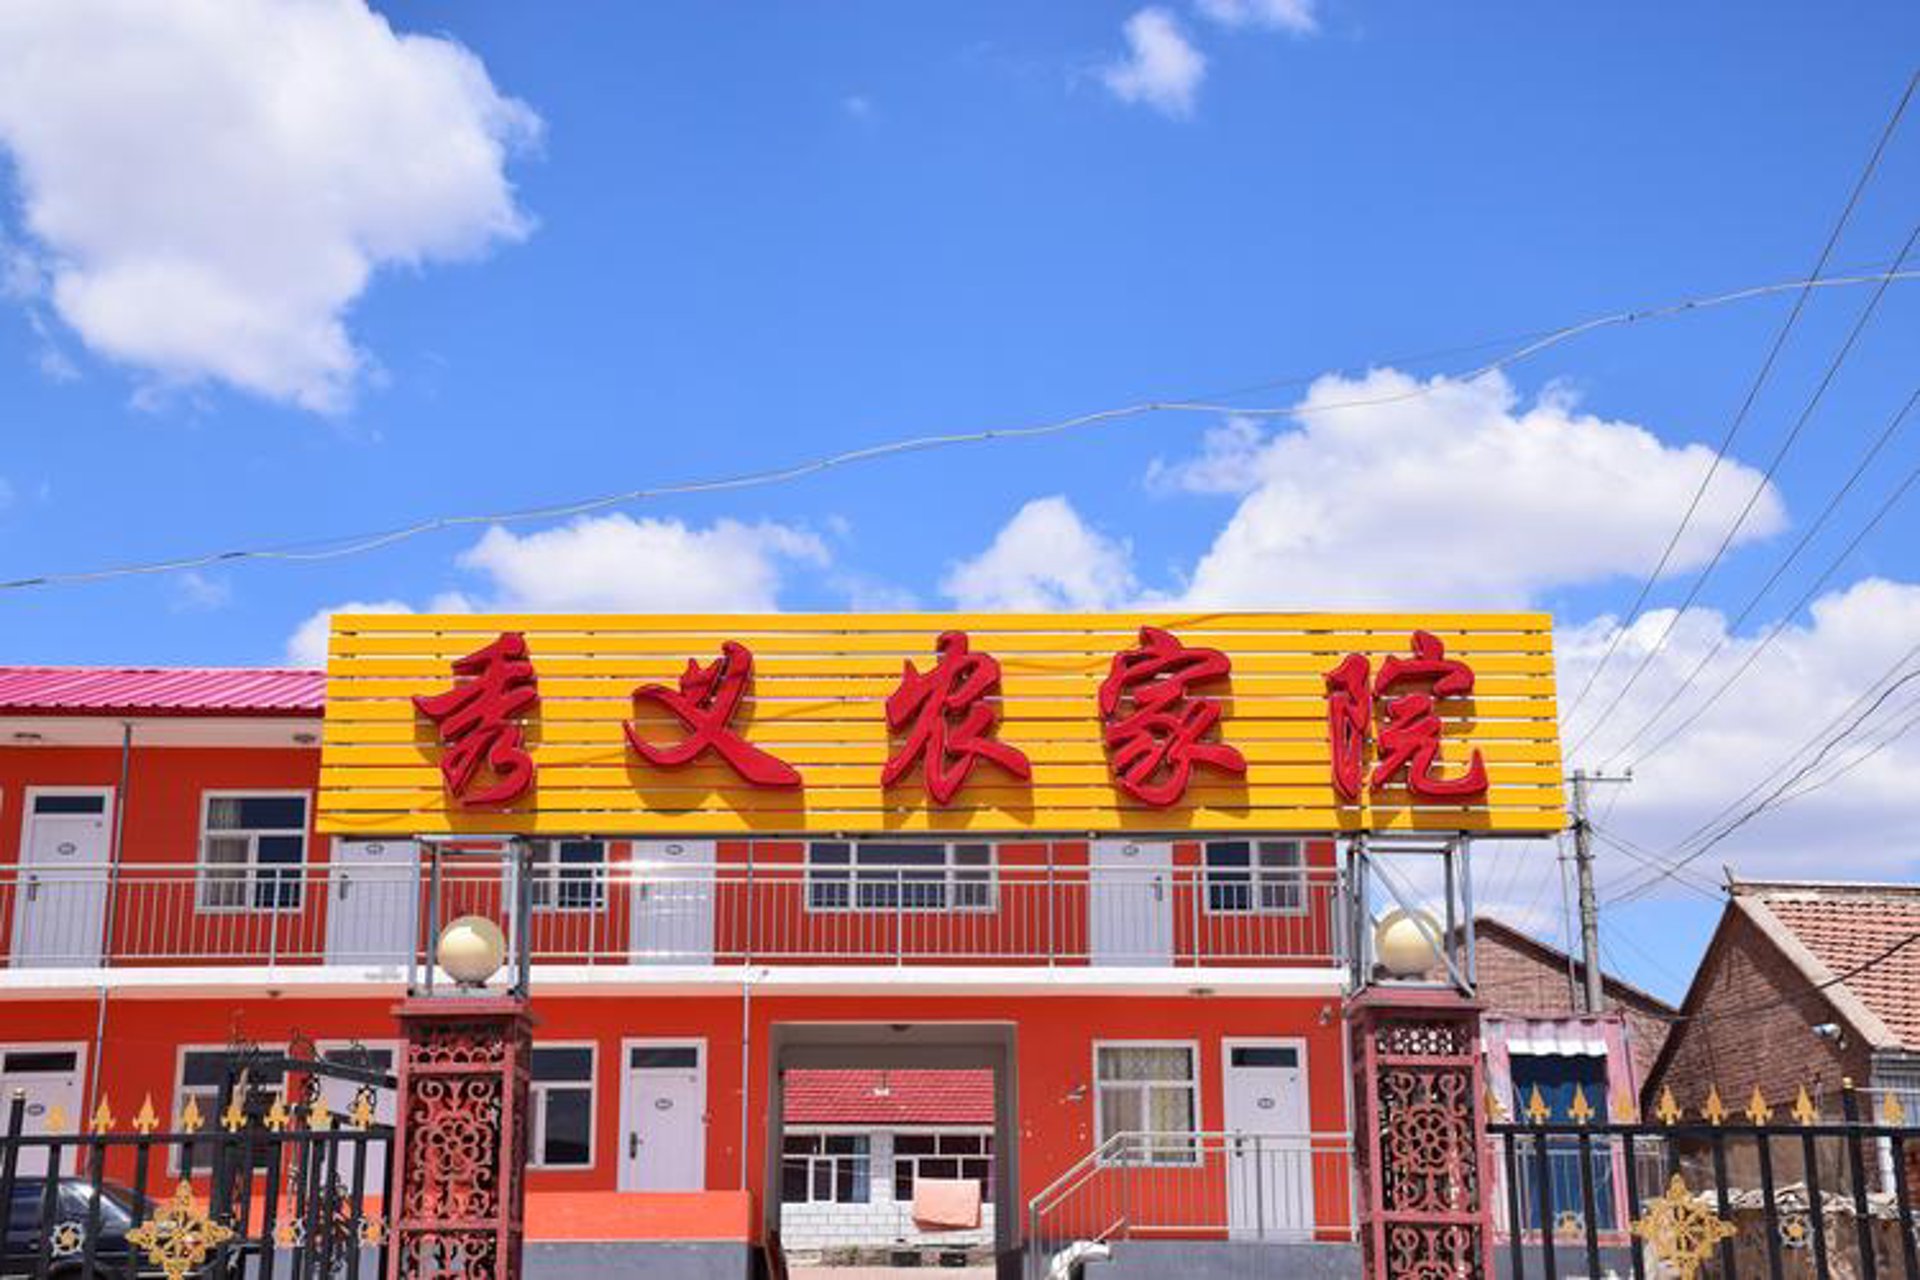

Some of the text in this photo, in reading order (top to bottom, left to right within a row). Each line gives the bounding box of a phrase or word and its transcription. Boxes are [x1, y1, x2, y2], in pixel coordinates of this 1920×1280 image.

[412, 627, 1488, 809] 秀义农家院
